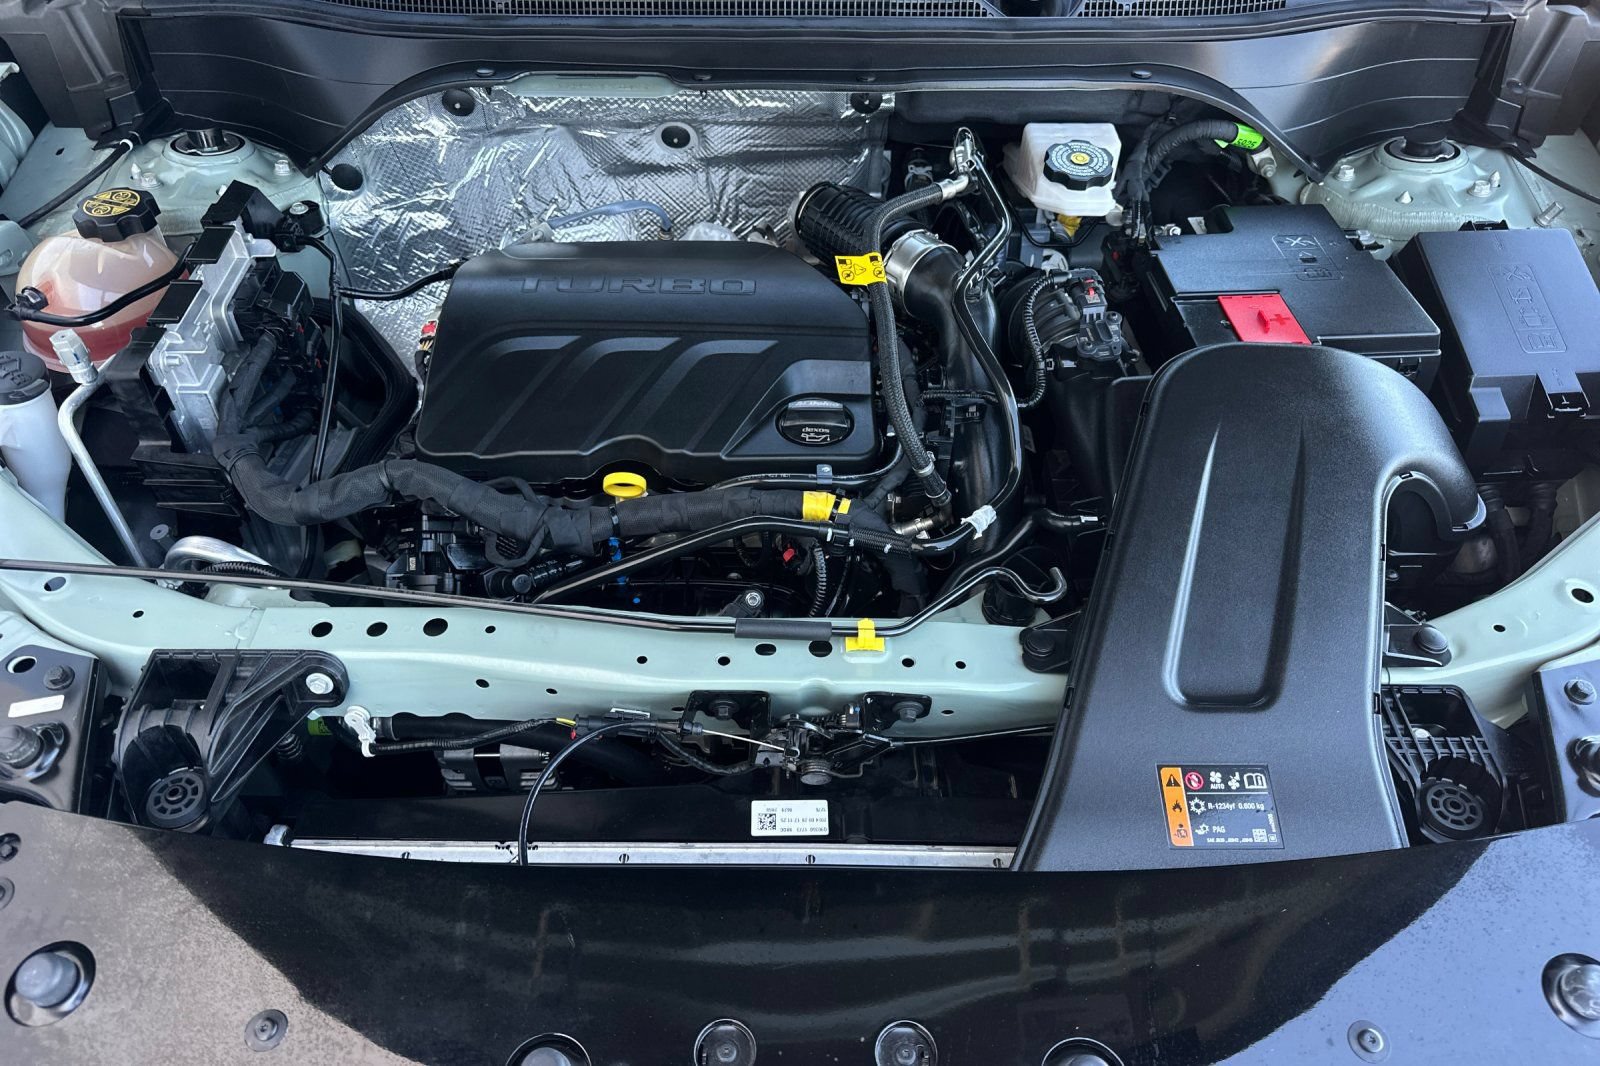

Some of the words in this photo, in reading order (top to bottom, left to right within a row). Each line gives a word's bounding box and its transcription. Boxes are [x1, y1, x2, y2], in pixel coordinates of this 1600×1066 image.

[509, 277, 757, 295] TURBO
[1208, 802, 1235, 811] R-1234yf
[1256, 802, 1265, 811] kg
[1212, 825, 1226, 833] PAG
